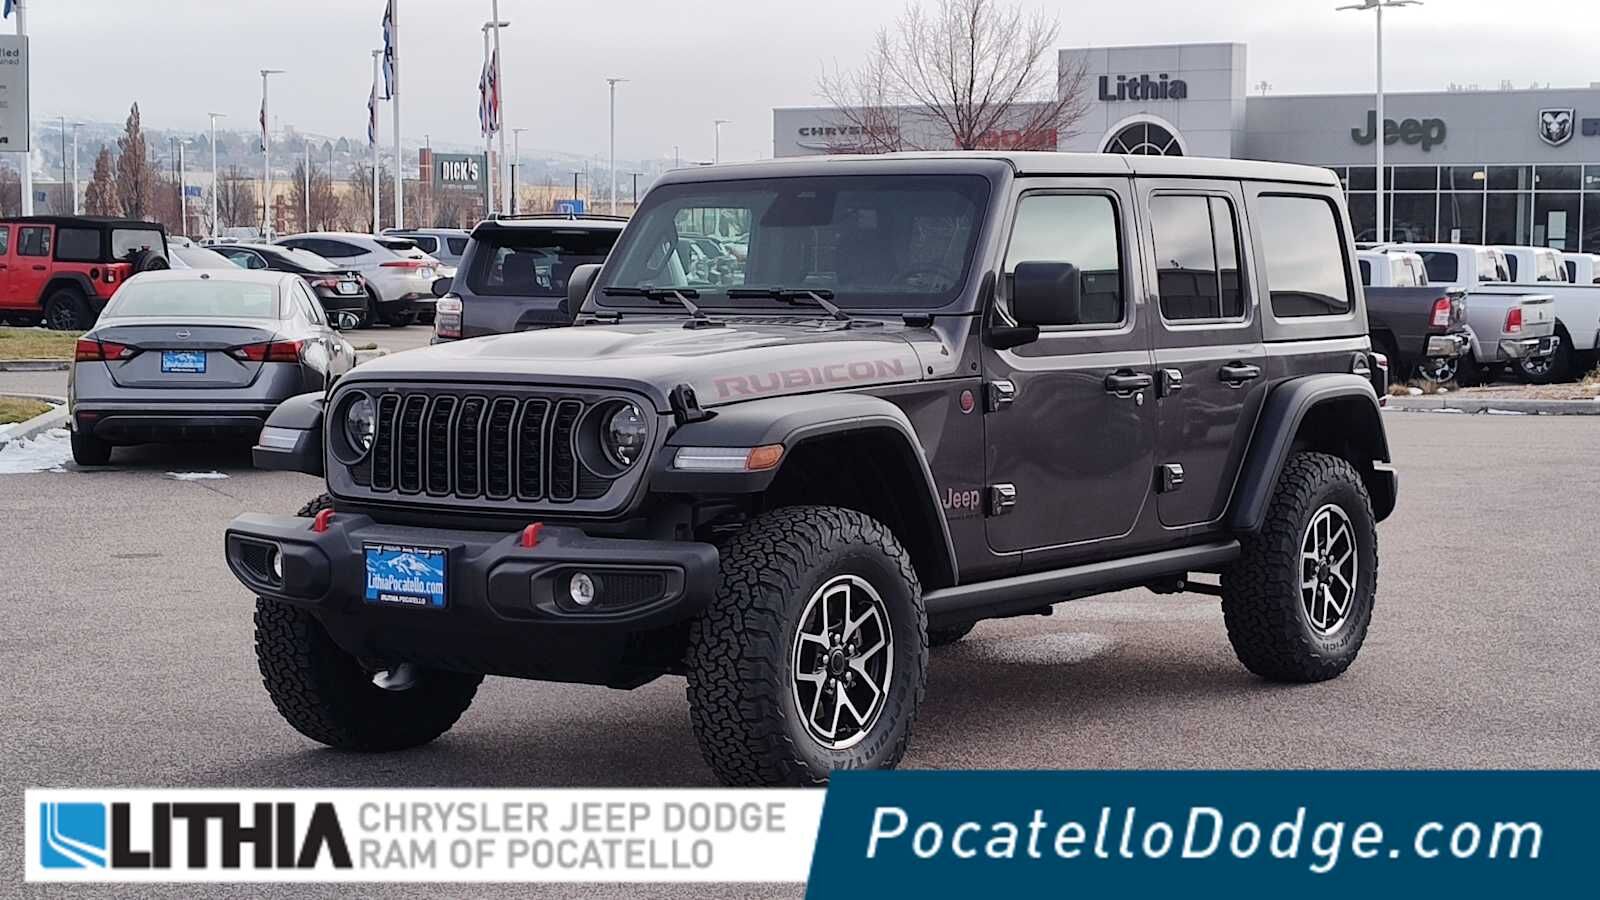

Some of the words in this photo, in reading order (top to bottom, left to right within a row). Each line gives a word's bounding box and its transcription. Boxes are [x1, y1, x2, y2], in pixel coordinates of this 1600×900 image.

[1099, 73, 1187, 101] Lithia
[1351, 110, 1447, 152] Jeep
[442, 157, 478, 181] DICK'S
[711, 358, 906, 400] RUBICON
[942, 488, 980, 510] Jeep
